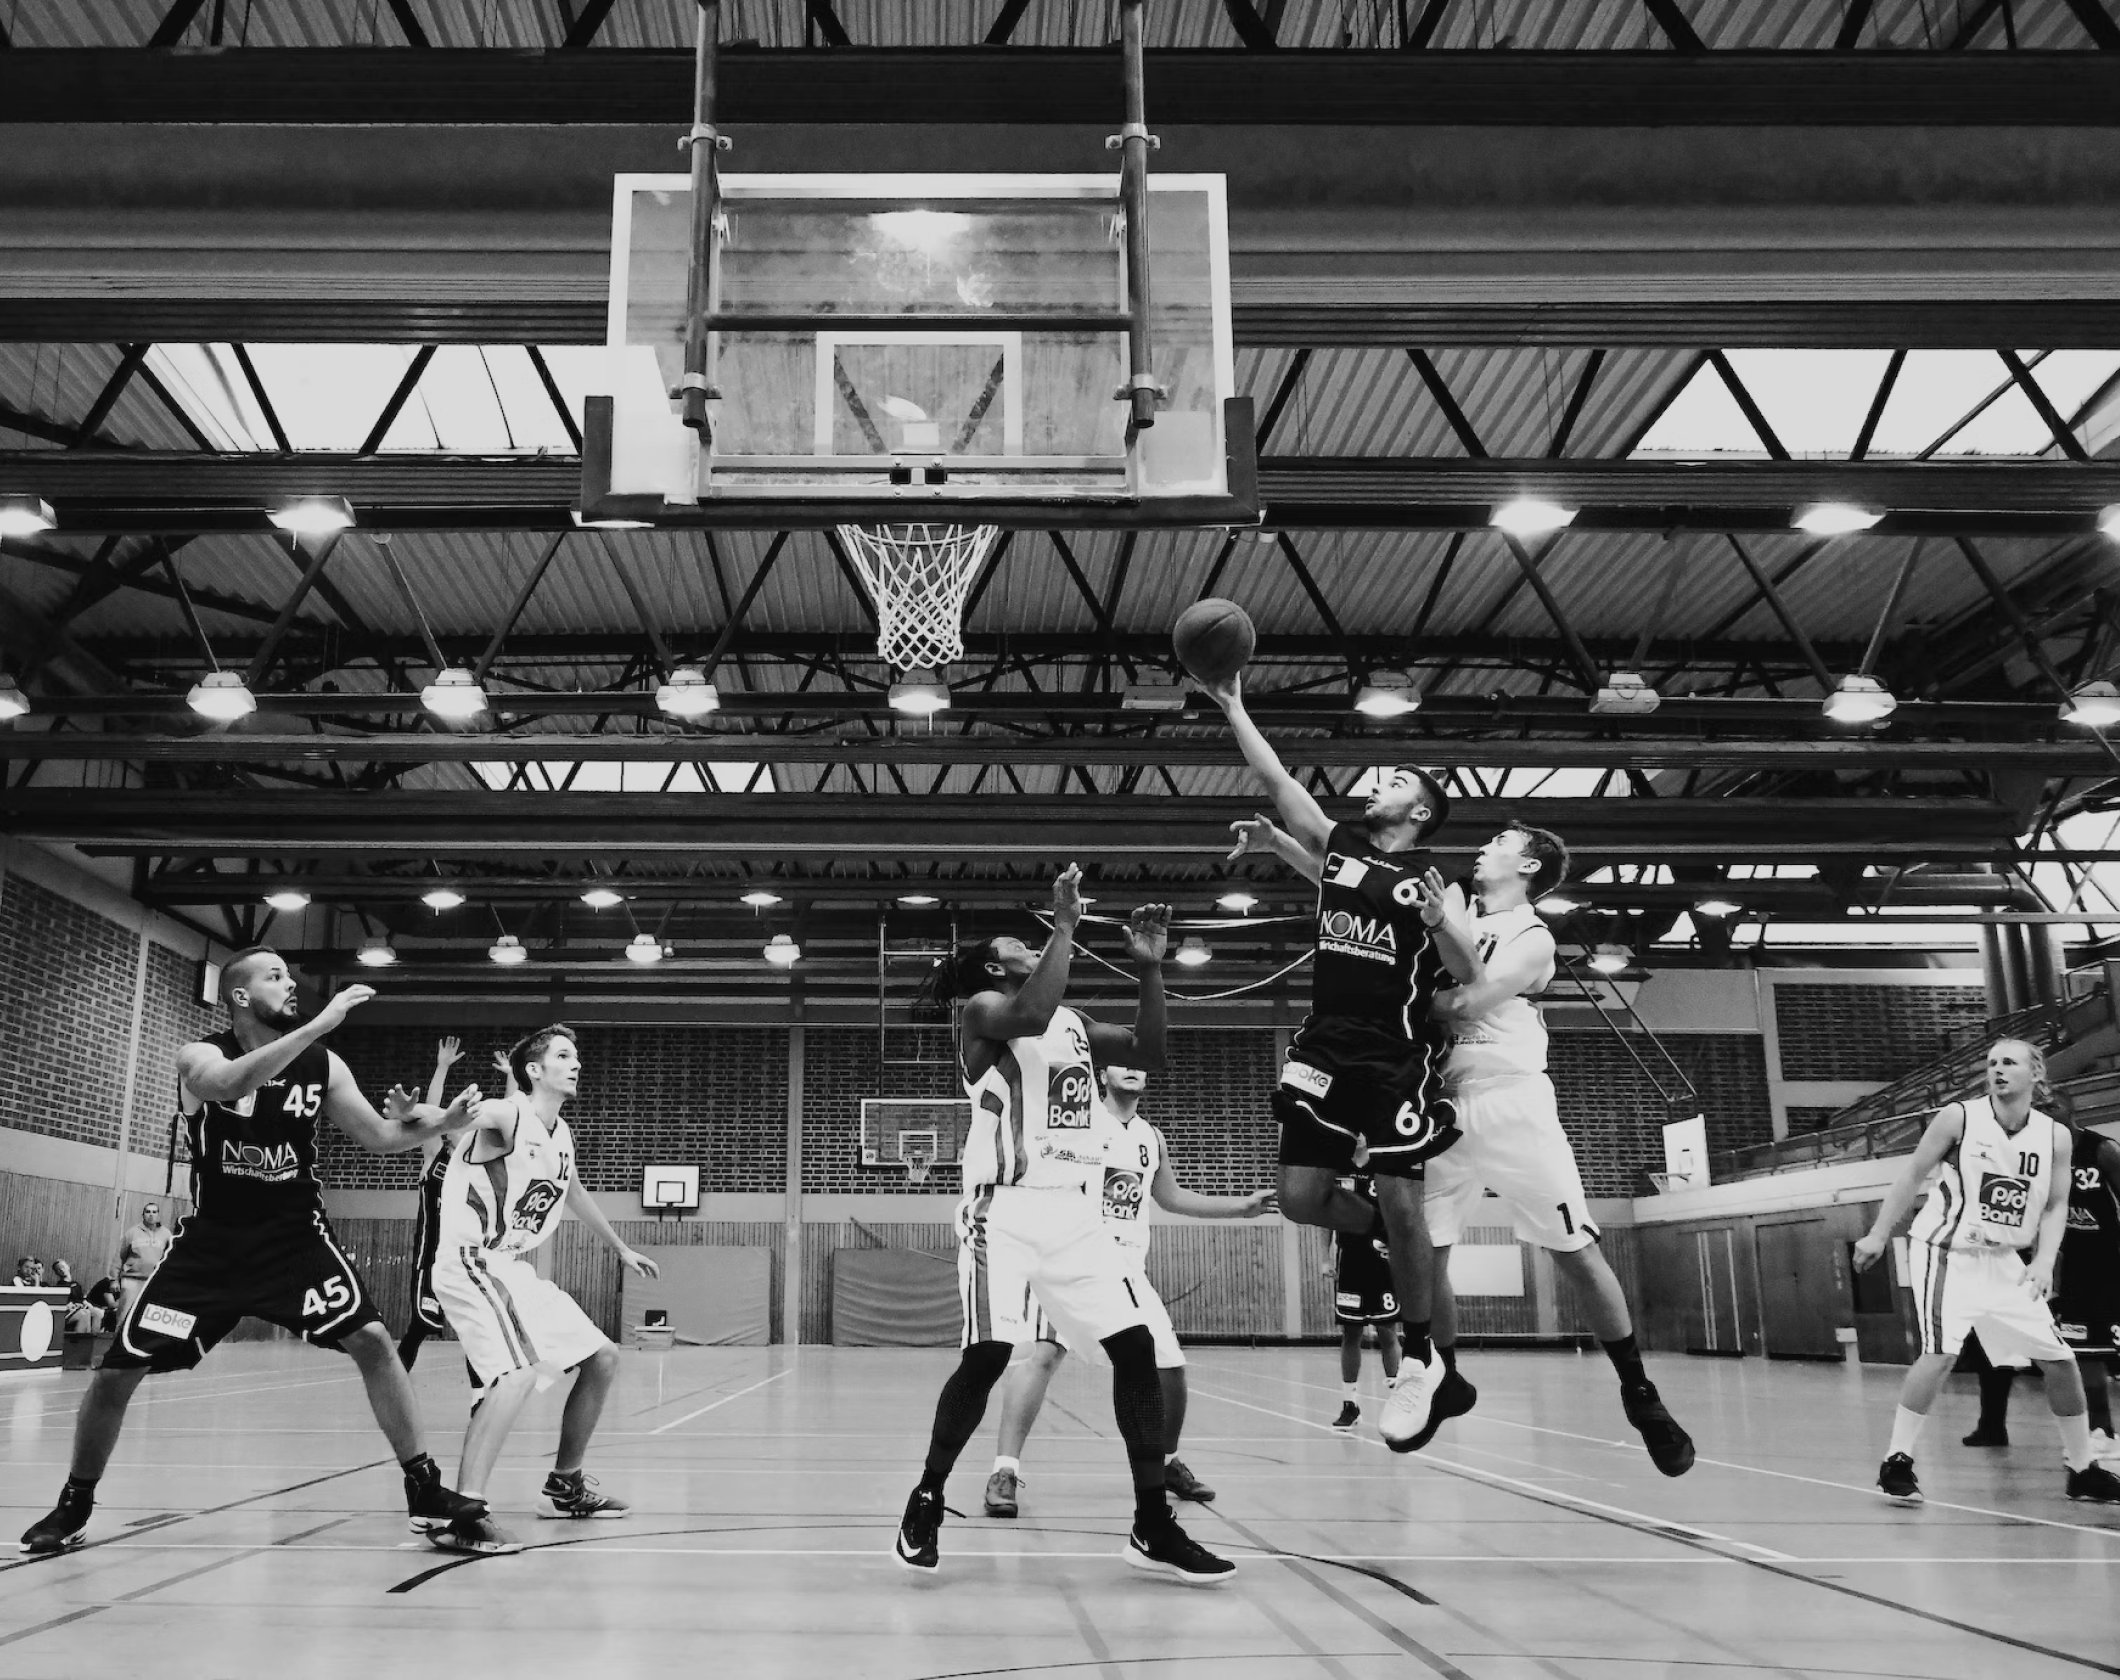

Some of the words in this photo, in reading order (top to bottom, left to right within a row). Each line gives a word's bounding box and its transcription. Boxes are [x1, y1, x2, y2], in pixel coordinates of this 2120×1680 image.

[1393, 877, 1421, 906] 6
[1319, 910, 1397, 951] NOMA
[283, 1083, 322, 1118] 45
[1049, 1105, 1090, 1127] Bank
[1395, 1100, 1422, 1136] 6
[222, 1139, 298, 1170] NOMA
[558, 1151, 570, 1181] 12
[1138, 1144, 1149, 1167] 8
[2018, 1151, 2039, 1178] 10
[2074, 1167, 2101, 1190] 32
[1103, 1200, 1137, 1220] Bank
[1980, 1202, 2022, 1226] Bank
[302, 1275, 350, 1316] 45
[1382, 1292, 1397, 1312] 8
[143, 1306, 192, 1330] Löbke
